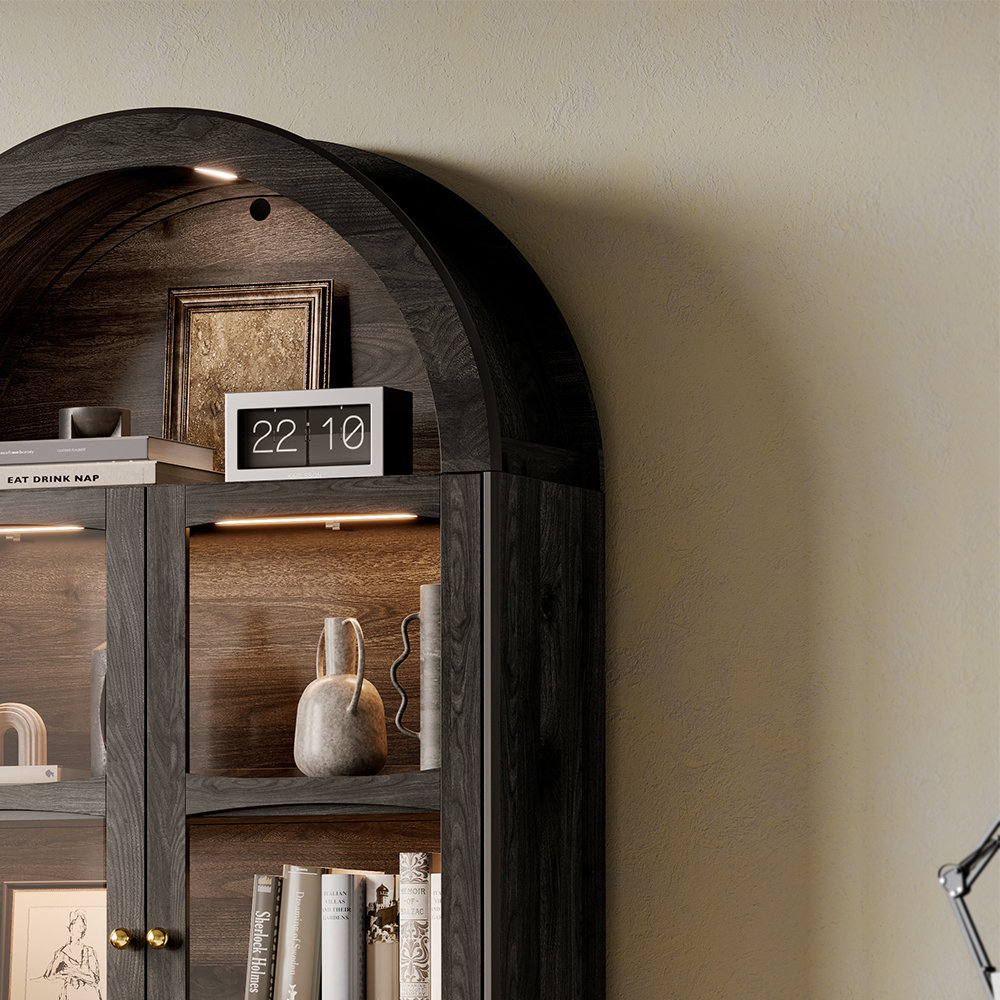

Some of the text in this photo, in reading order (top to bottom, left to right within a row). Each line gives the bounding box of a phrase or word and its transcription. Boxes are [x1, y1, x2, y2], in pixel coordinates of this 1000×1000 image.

[252, 414, 365, 454] 22 10
[7, 473, 99, 485] EAT DRINK NAP
[249, 910, 271, 993] Sherlock Holmes
